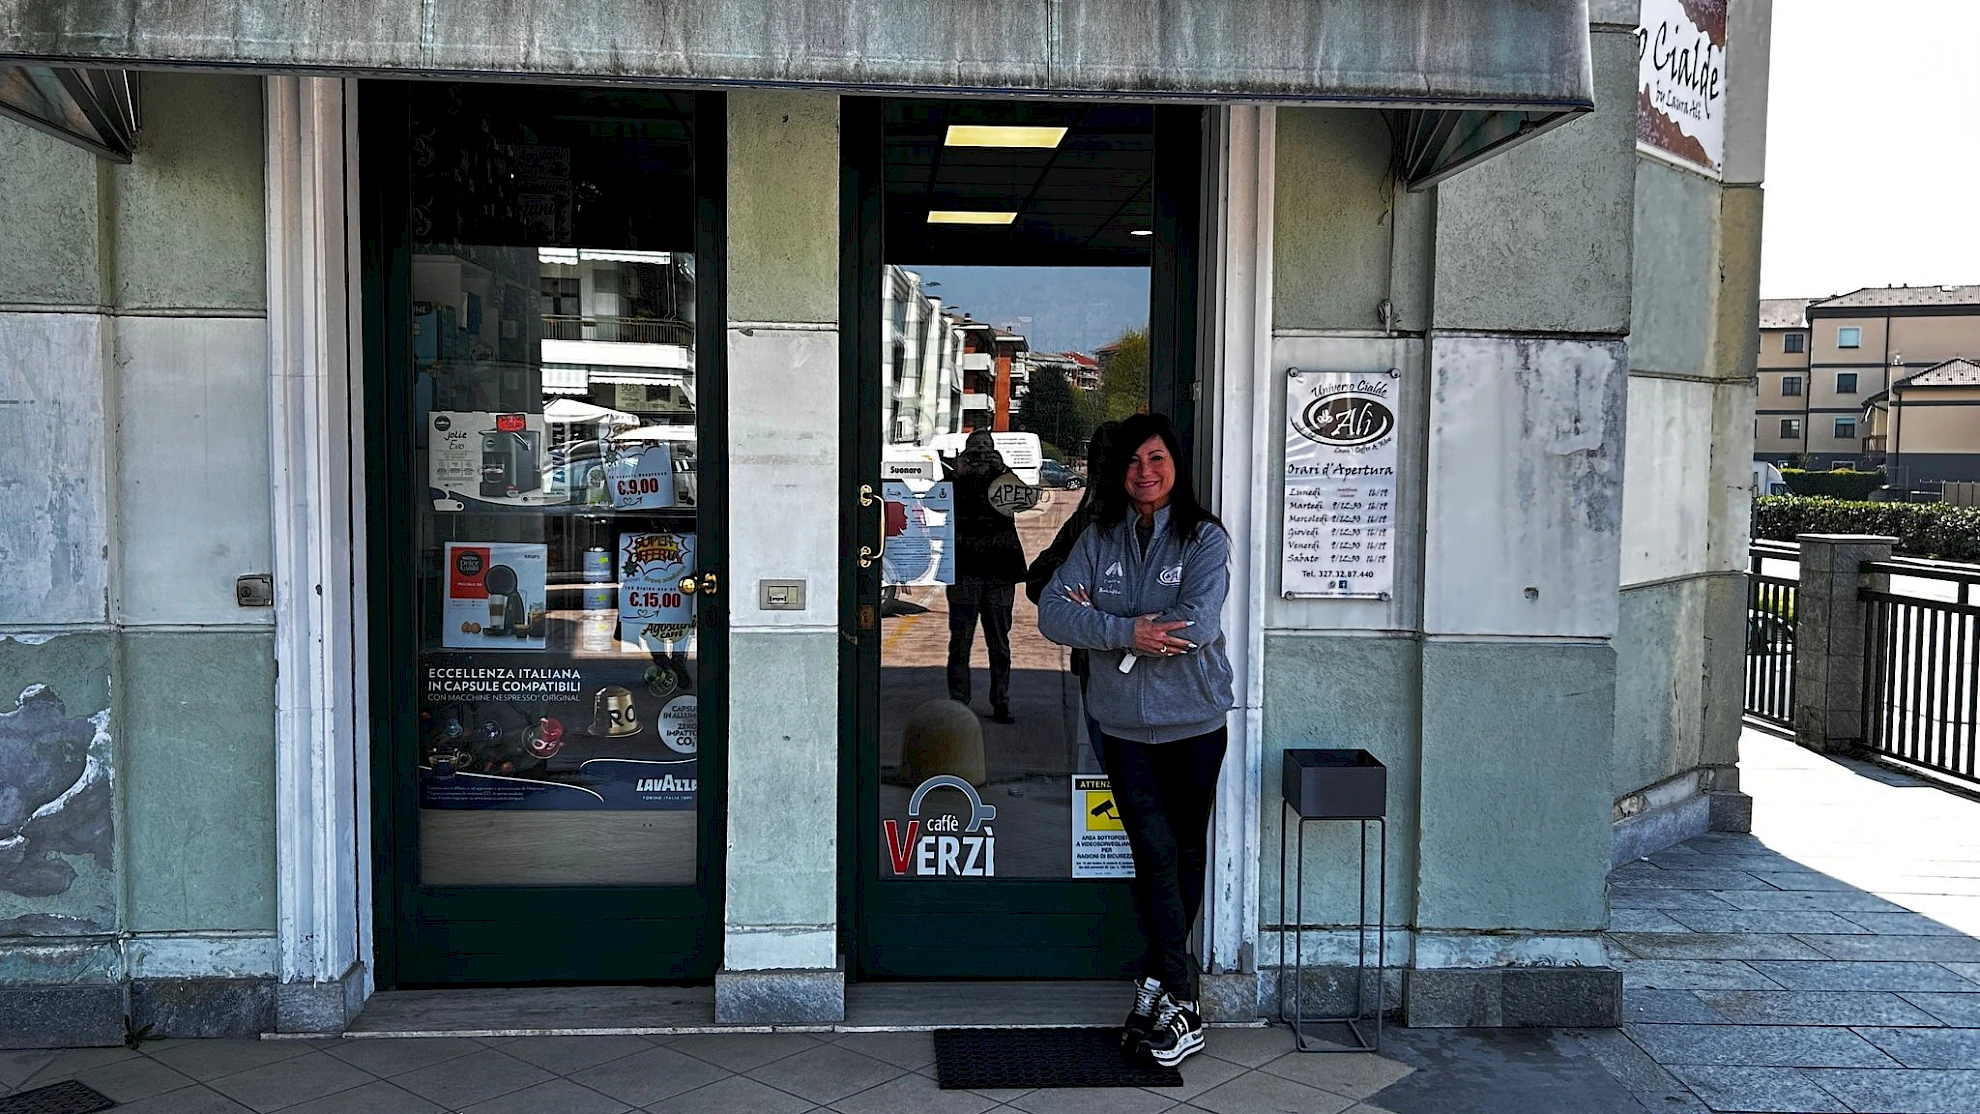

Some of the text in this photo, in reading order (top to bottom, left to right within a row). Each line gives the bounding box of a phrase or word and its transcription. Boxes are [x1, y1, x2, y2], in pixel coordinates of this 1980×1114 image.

[1653, 21, 1719, 119] Cialde
[1310, 379, 1388, 398] Universo Cialde
[890, 466, 922, 474] Suonare
[1287, 463, 1394, 482] Orari d'Apertura
[990, 484, 1050, 504] APERTO
[1287, 553, 1319, 562] Sabato
[1302, 570, 1374, 578] Tel. 327.32.87.440
[428, 668, 581, 679] ECCELLENZA ITALIANA
[428, 681, 581, 692] IN CAPSULE COMPATIBILI
[427, 693, 448, 702] CON
[448, 694, 491, 702] MACCHINE
[542, 694, 581, 702] ORIGINAL
[927, 814, 959, 832] caffè
[883, 819, 995, 877] VERZÌ
